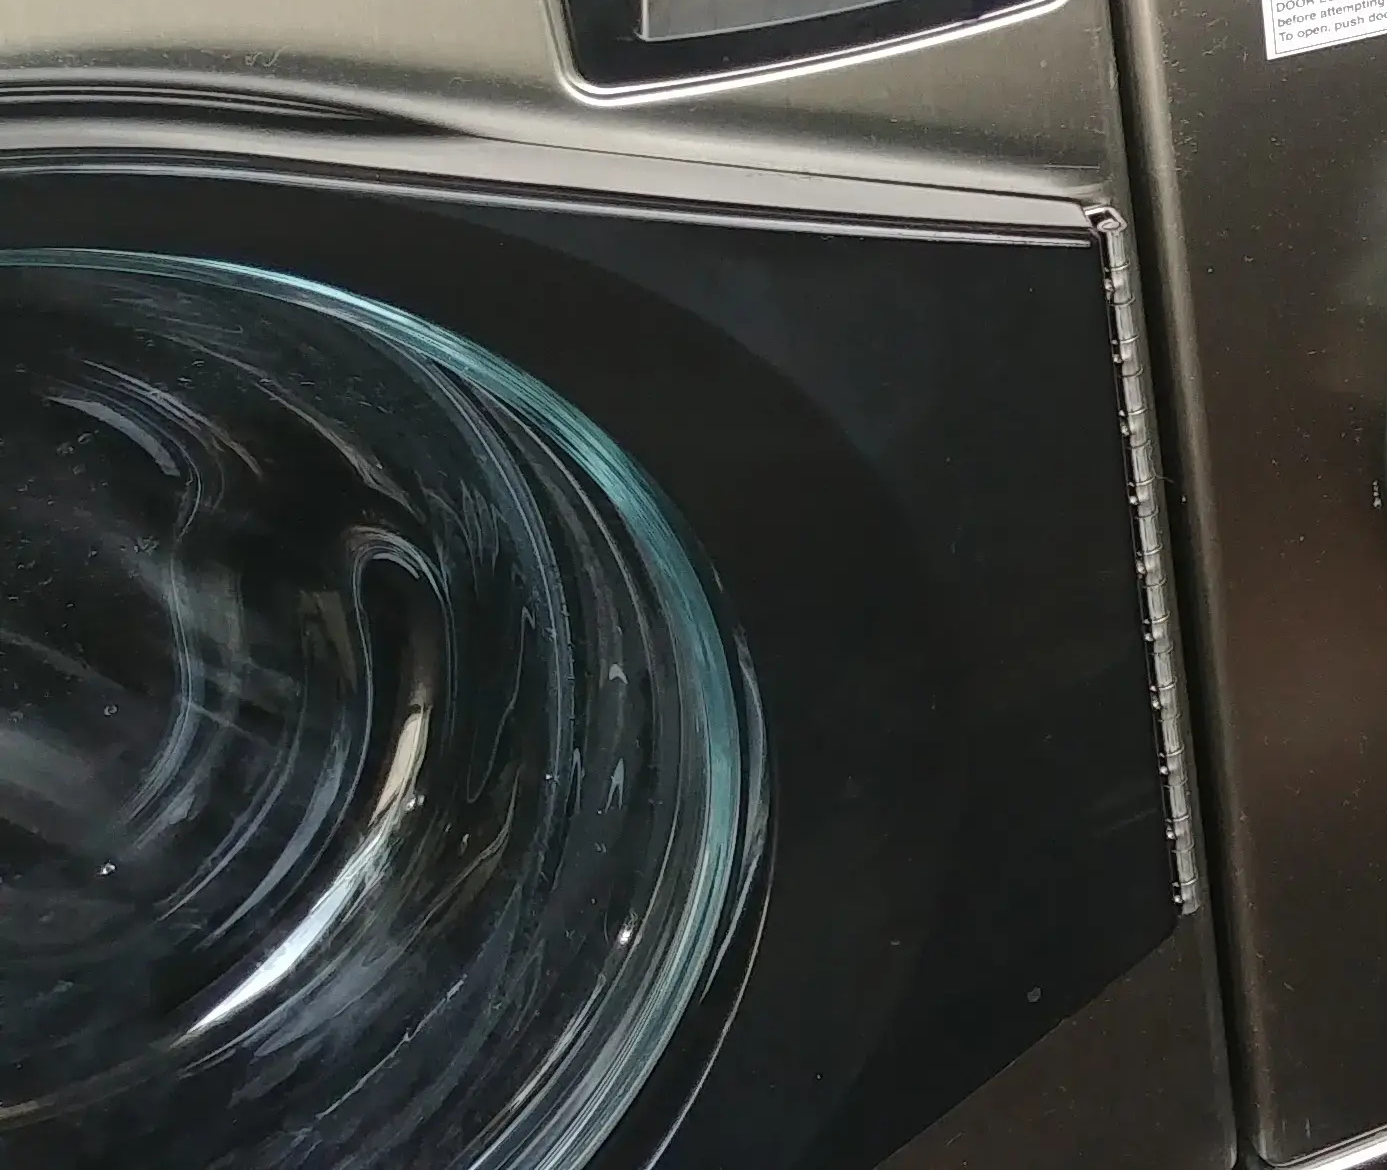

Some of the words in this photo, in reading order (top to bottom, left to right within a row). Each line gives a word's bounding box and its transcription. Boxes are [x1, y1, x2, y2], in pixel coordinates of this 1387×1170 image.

[1277, 12, 1317, 28] before
[1278, 31, 1294, 42] To
[1296, 25, 1328, 39] open,
[1334, 16, 1365, 32] push
